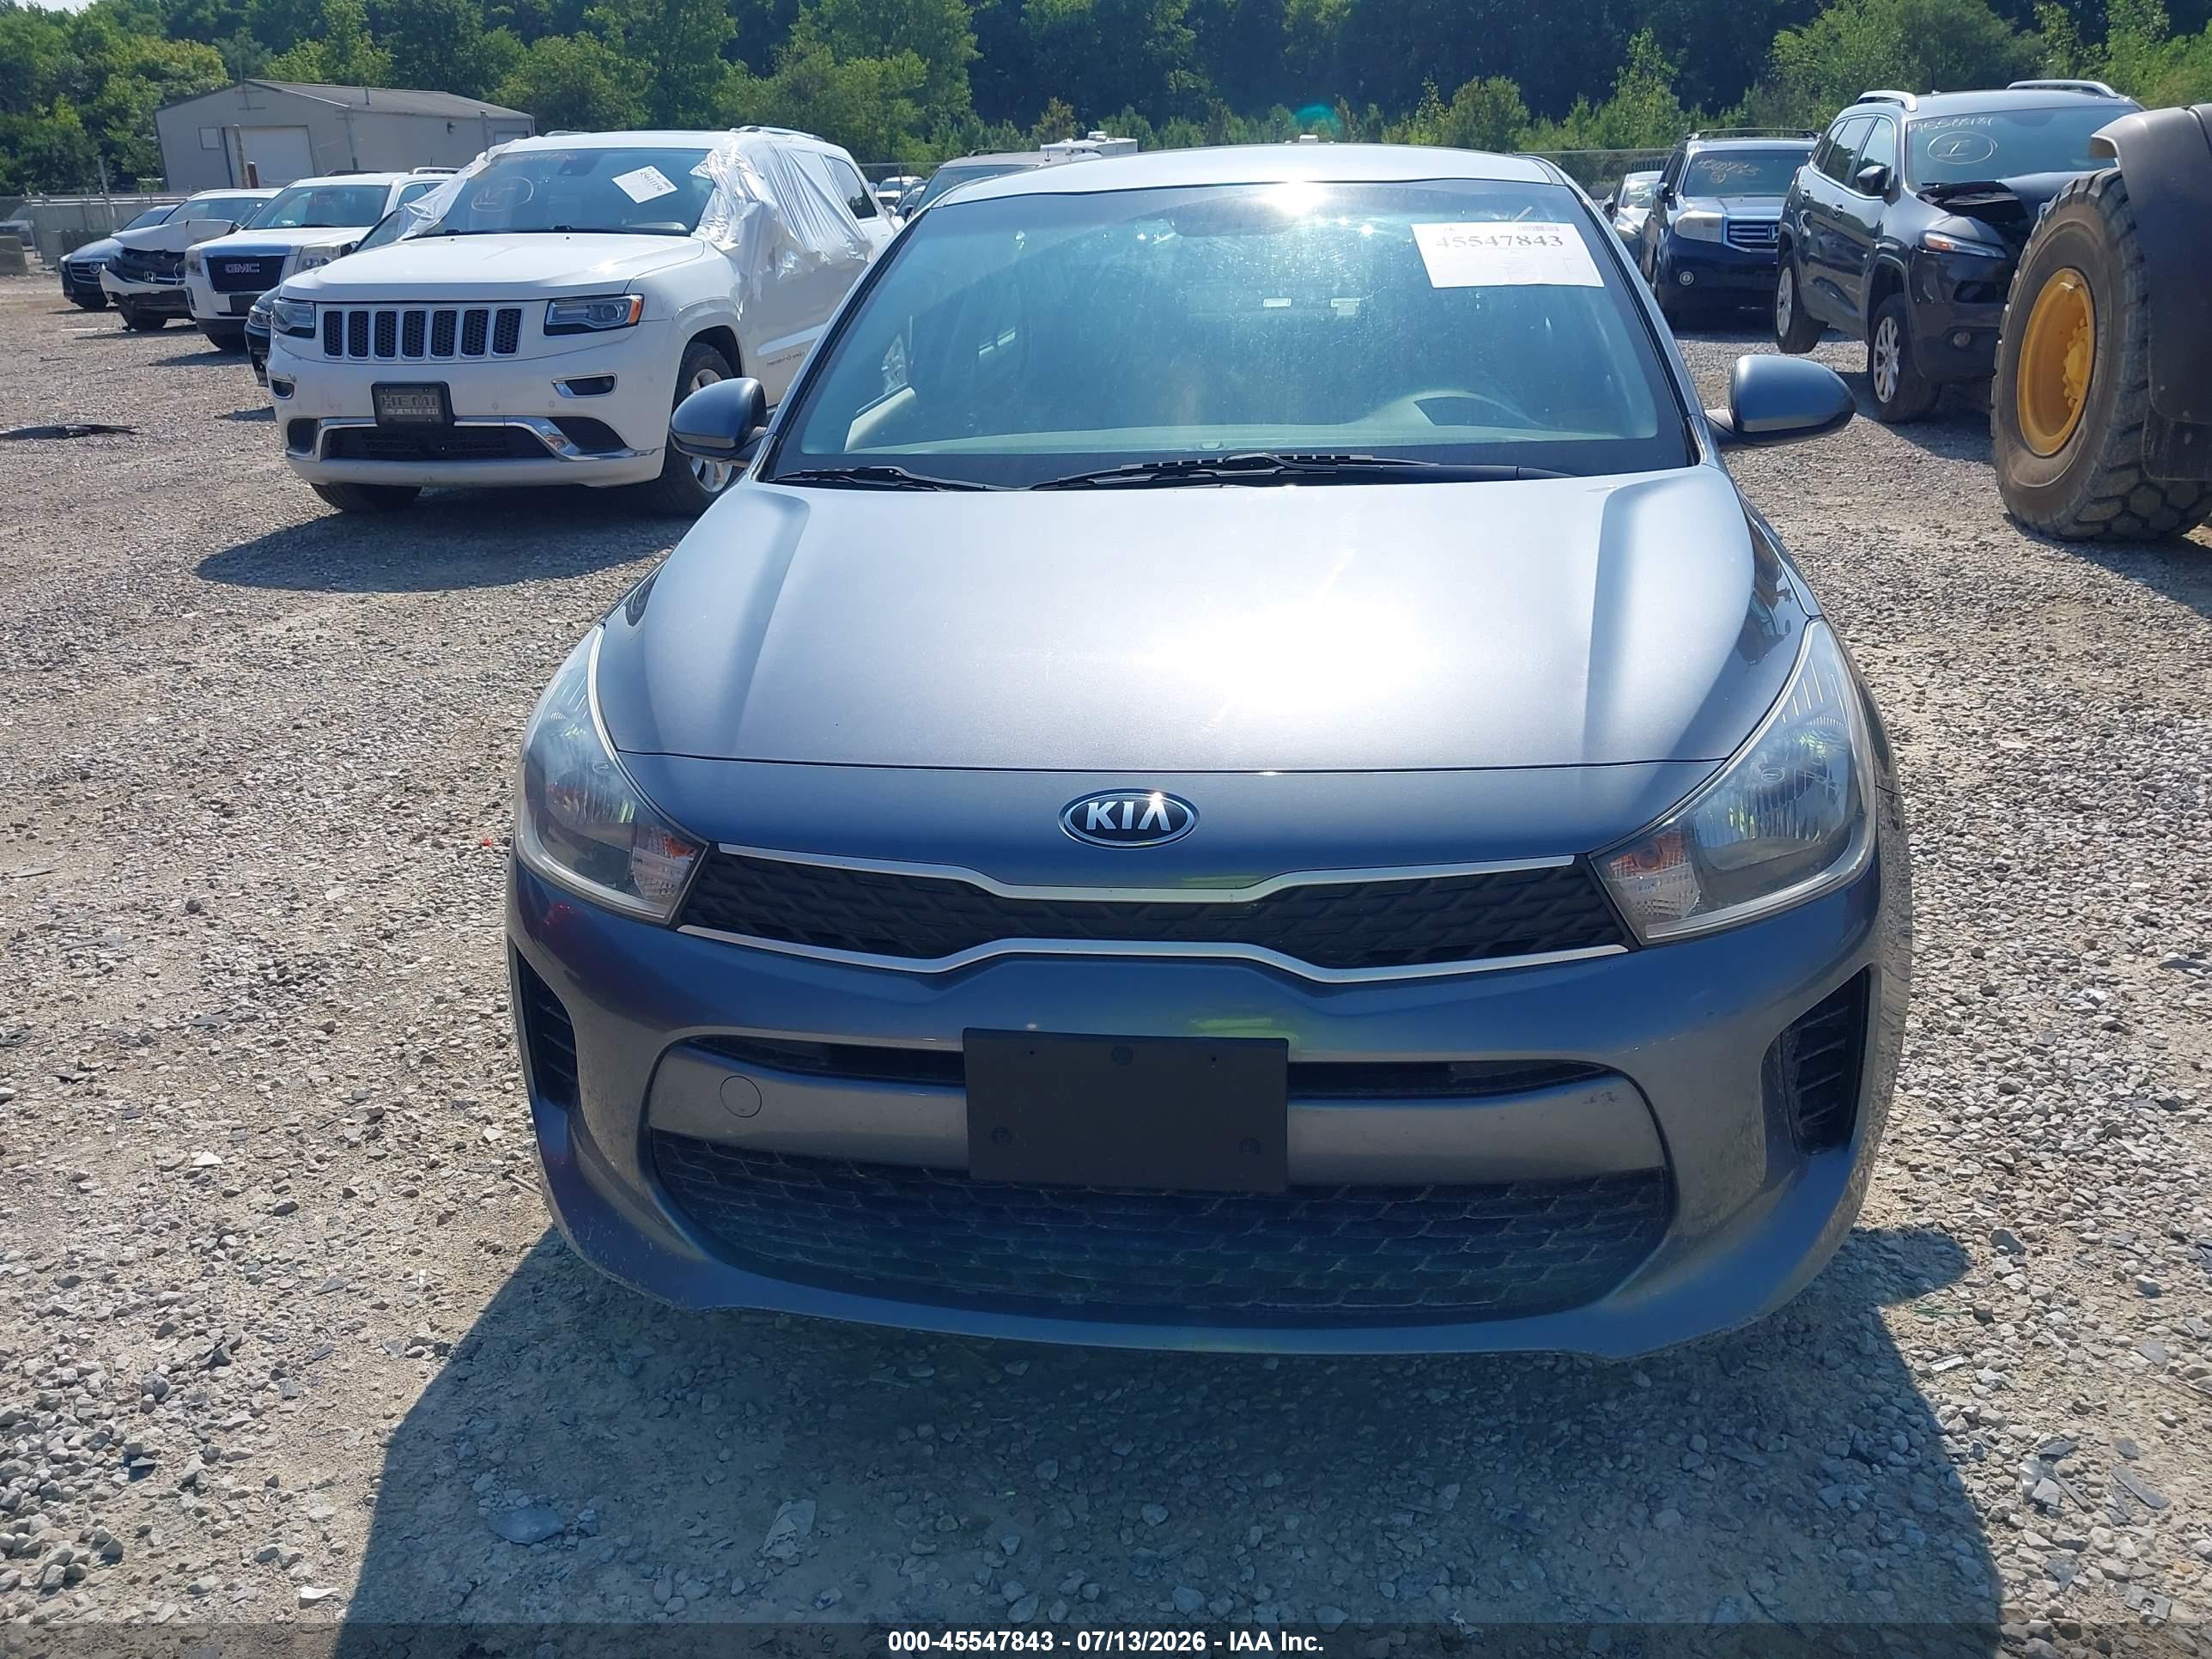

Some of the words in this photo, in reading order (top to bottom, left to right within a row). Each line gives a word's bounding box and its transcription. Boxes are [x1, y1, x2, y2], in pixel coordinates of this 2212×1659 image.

[1436, 234, 1563, 248] 45547843
[225, 263, 259, 273] GMC
[380, 395, 439, 408] HEMI
[1086, 800, 1171, 831] KIA
